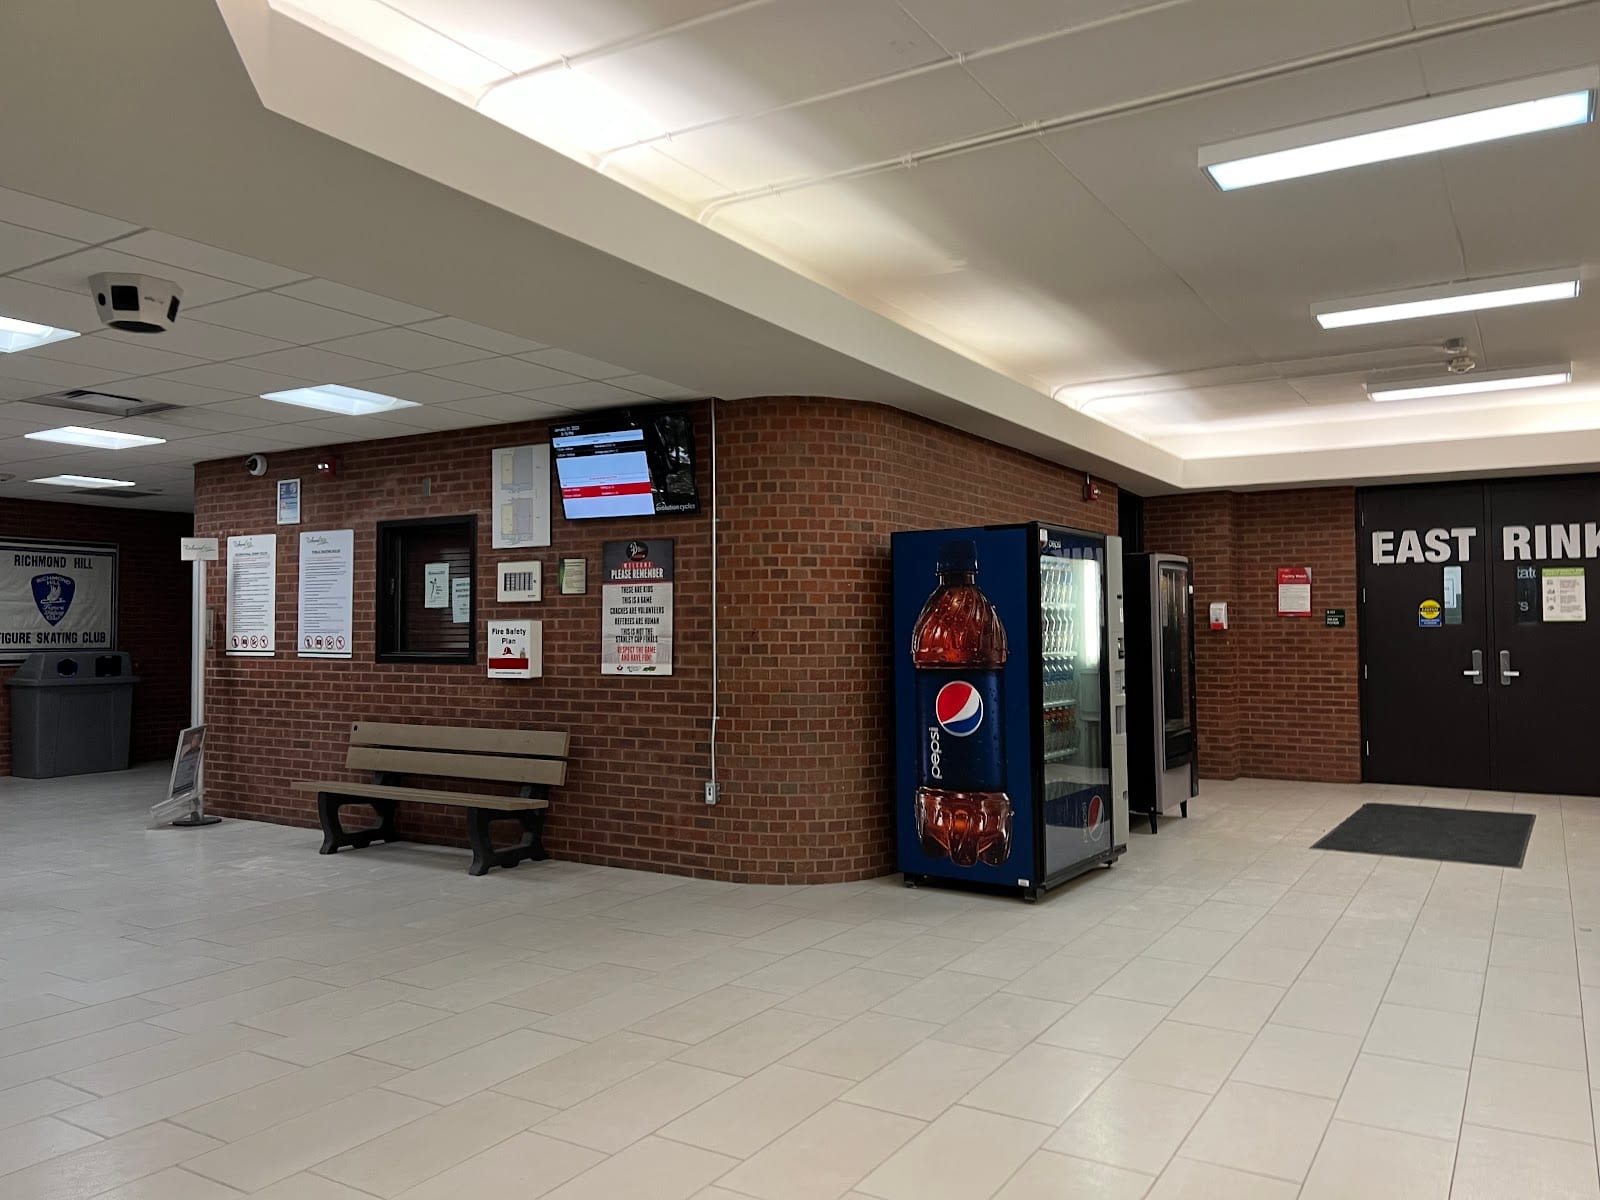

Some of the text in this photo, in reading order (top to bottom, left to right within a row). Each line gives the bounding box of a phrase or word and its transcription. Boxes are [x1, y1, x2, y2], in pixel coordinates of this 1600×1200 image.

[1048, 540, 1061, 550] pepsi
[1372, 527, 1477, 564] EAST
[14, 554, 94, 570] RICHMOND HILL
[611, 567, 664, 579] PLEASE REMEMBER
[36, 576, 71, 585] RICHMOND
[621, 585, 654, 594] THESE ARE KIDS
[622, 596, 632, 604] THIS
[641, 596, 652, 604] GAME
[610, 606, 665, 615] COACHES ARE VOLUNTEERS
[614, 617, 660, 625] REFEREES ARE HUMAN
[491, 628, 527, 636] Fire Safety
[620, 627, 630, 636] THIS
[0, 631, 106, 645] IGURE SKATING CLUB
[501, 637, 517, 645] Plan
[615, 635, 634, 643] STANLEY
[634, 635, 643, 643] CUP
[617, 646, 635, 654] RESPECT
[928, 726, 943, 780] pepsi
